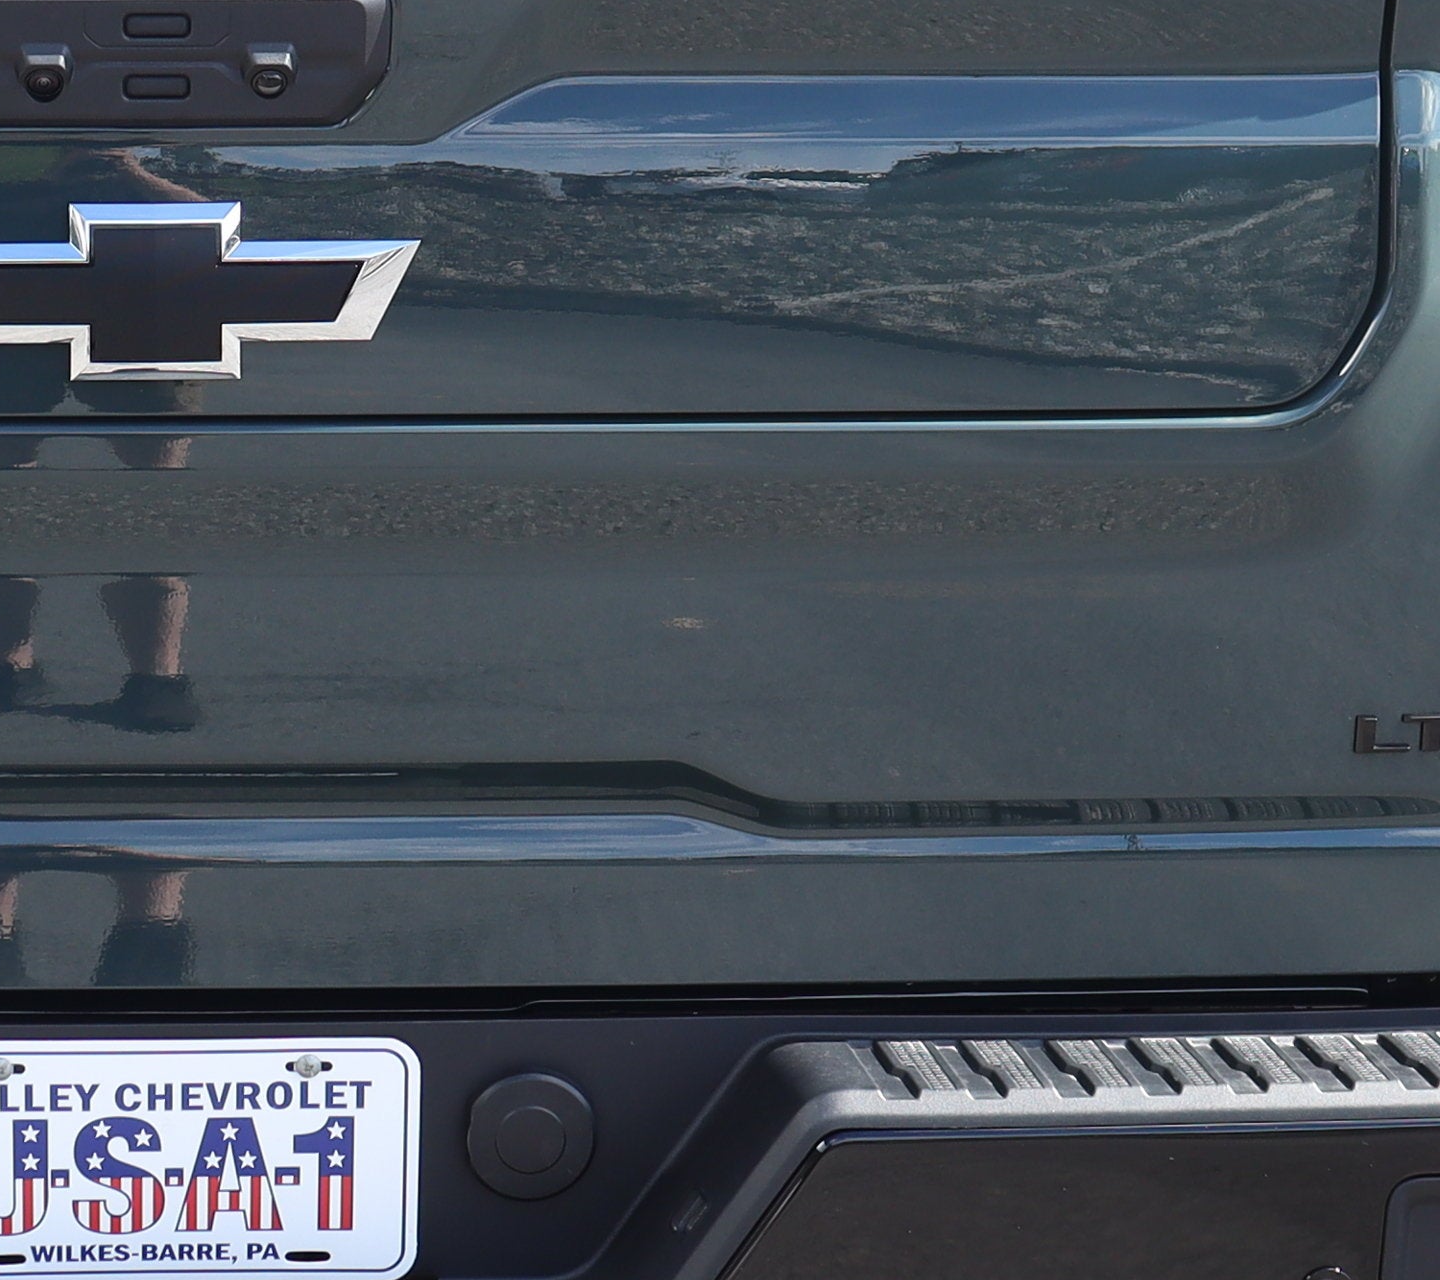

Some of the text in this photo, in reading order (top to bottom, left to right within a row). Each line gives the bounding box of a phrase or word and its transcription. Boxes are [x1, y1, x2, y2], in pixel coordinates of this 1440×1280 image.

[114, 1080, 372, 1112] CHEVROLET
[31, 1243, 281, 1264] WILKES-BARRE, PA
